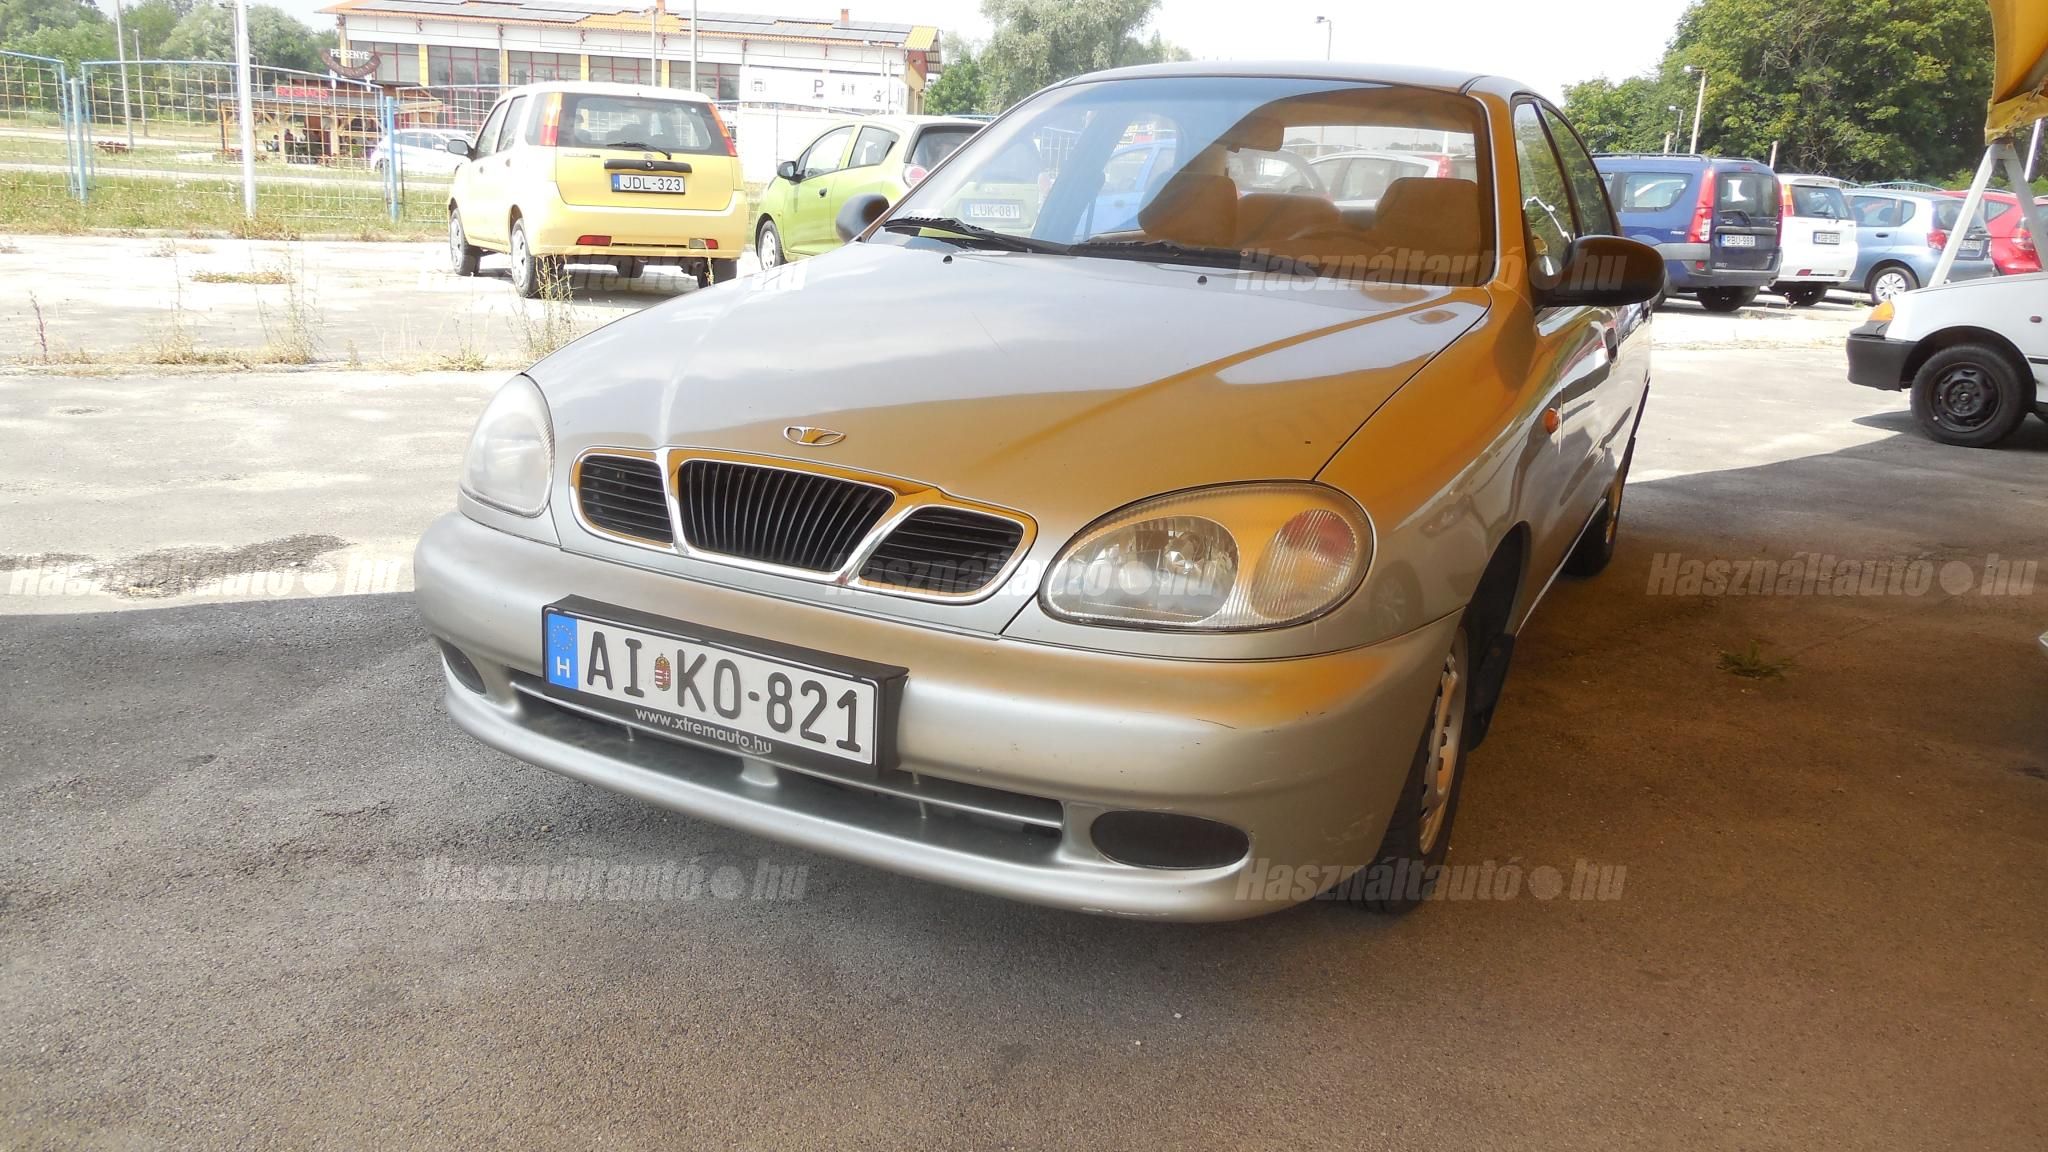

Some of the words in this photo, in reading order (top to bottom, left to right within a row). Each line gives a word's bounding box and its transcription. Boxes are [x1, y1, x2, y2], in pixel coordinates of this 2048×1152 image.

[330, 48, 370, 60] PESENYE
[623, 176, 681, 191] JDL-323
[972, 204, 1018, 217] LUK-081
[556, 656, 571, 680] H
[586, 630, 645, 698] AI
[676, 648, 862, 753] KO-821
[634, 707, 773, 755] www.xtremauto.hu
